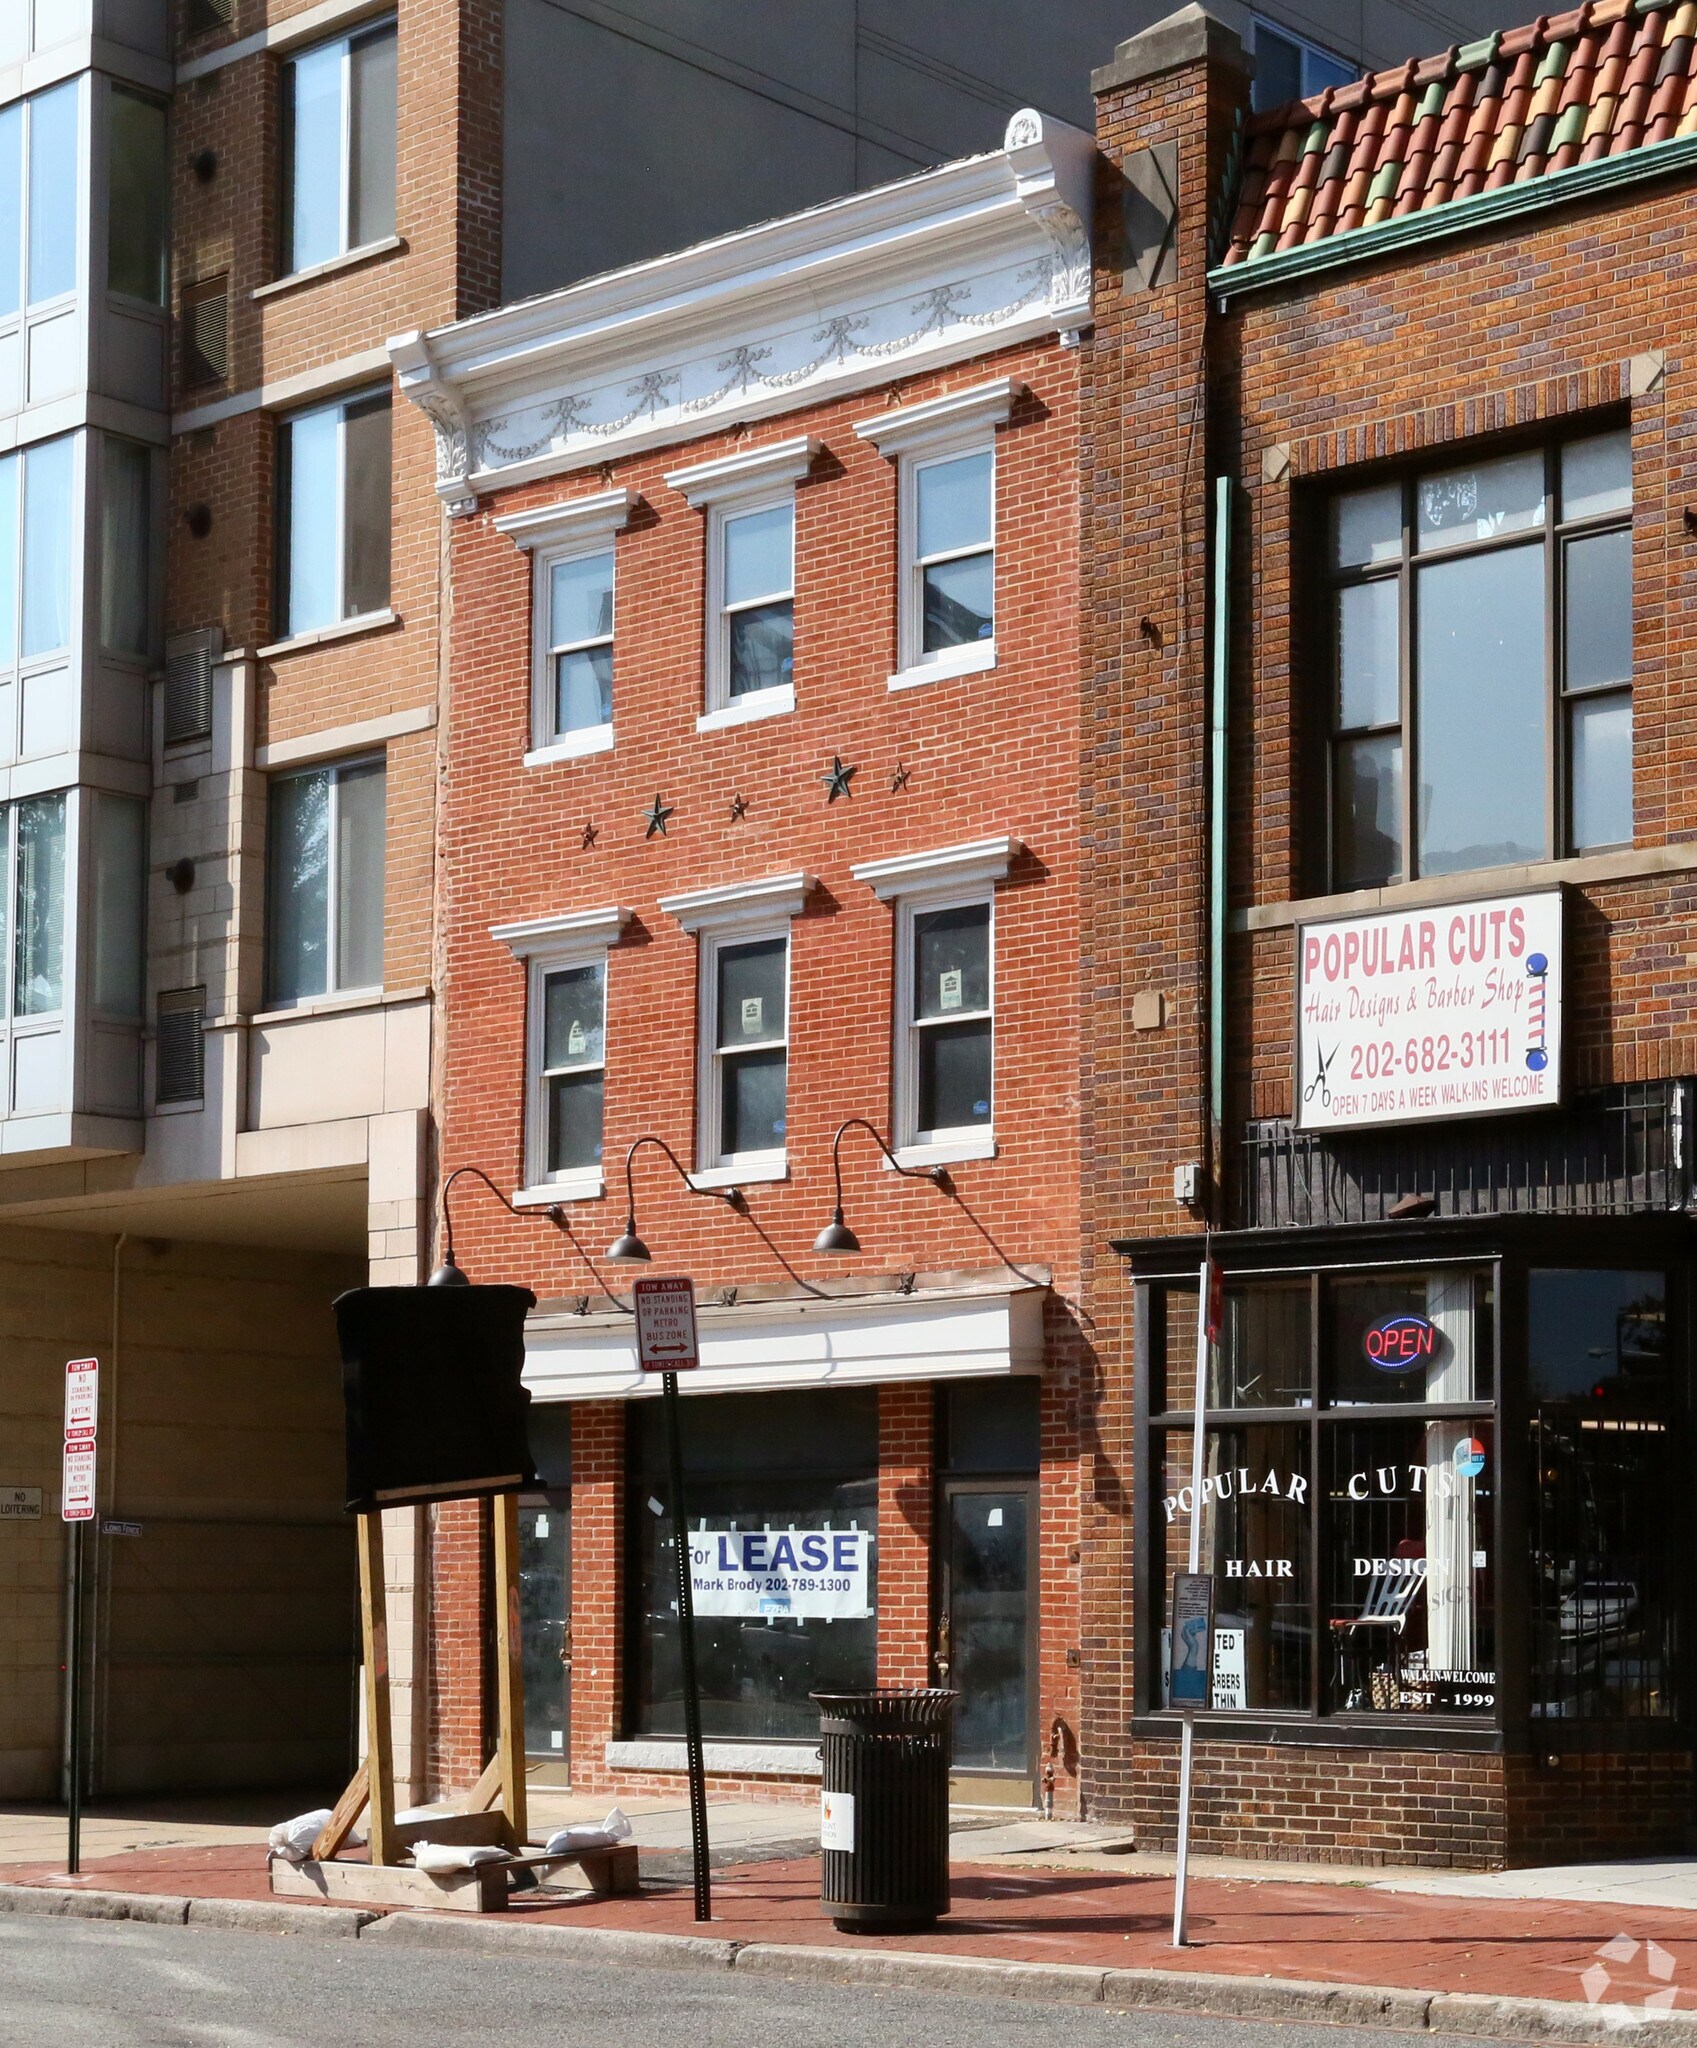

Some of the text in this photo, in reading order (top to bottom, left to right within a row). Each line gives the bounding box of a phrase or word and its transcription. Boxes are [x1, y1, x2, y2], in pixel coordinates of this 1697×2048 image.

[1305, 906, 1525, 984] POPULAR CUTS
[1305, 967, 1524, 1026] Hair Designs & Barber Shop
[1351, 1027, 1509, 1080] 202-682-3111
[1332, 1074, 1544, 1116] OPEN 7 DAYS A WEEK WALK-INS WELCOME
[641, 1295, 687, 1304] NO STANDING
[643, 1306, 688, 1316] OR PARKING
[654, 1319, 678, 1327] METRO
[647, 1330, 687, 1341] BUS ZONE
[1366, 1327, 1433, 1357] OPEN
[79, 1374, 86, 1382] NO
[71, 1406, 91, 1414] ANYTIME
[15, 1492, 25, 1502] NO
[1162, 1465, 1453, 1523] POPULAR CUTS
[1, 1504, 39, 1514] LOITERING
[718, 1535, 859, 1572] LEASE
[1225, 1557, 1450, 1577] HAIR DESIGN
[693, 1578, 850, 1593] Mark Brody 202-789-1300
[1217, 1635, 1235, 1650] TED
[1399, 1692, 1435, 1704] EST
[1454, 1694, 1494, 1706] 1999
